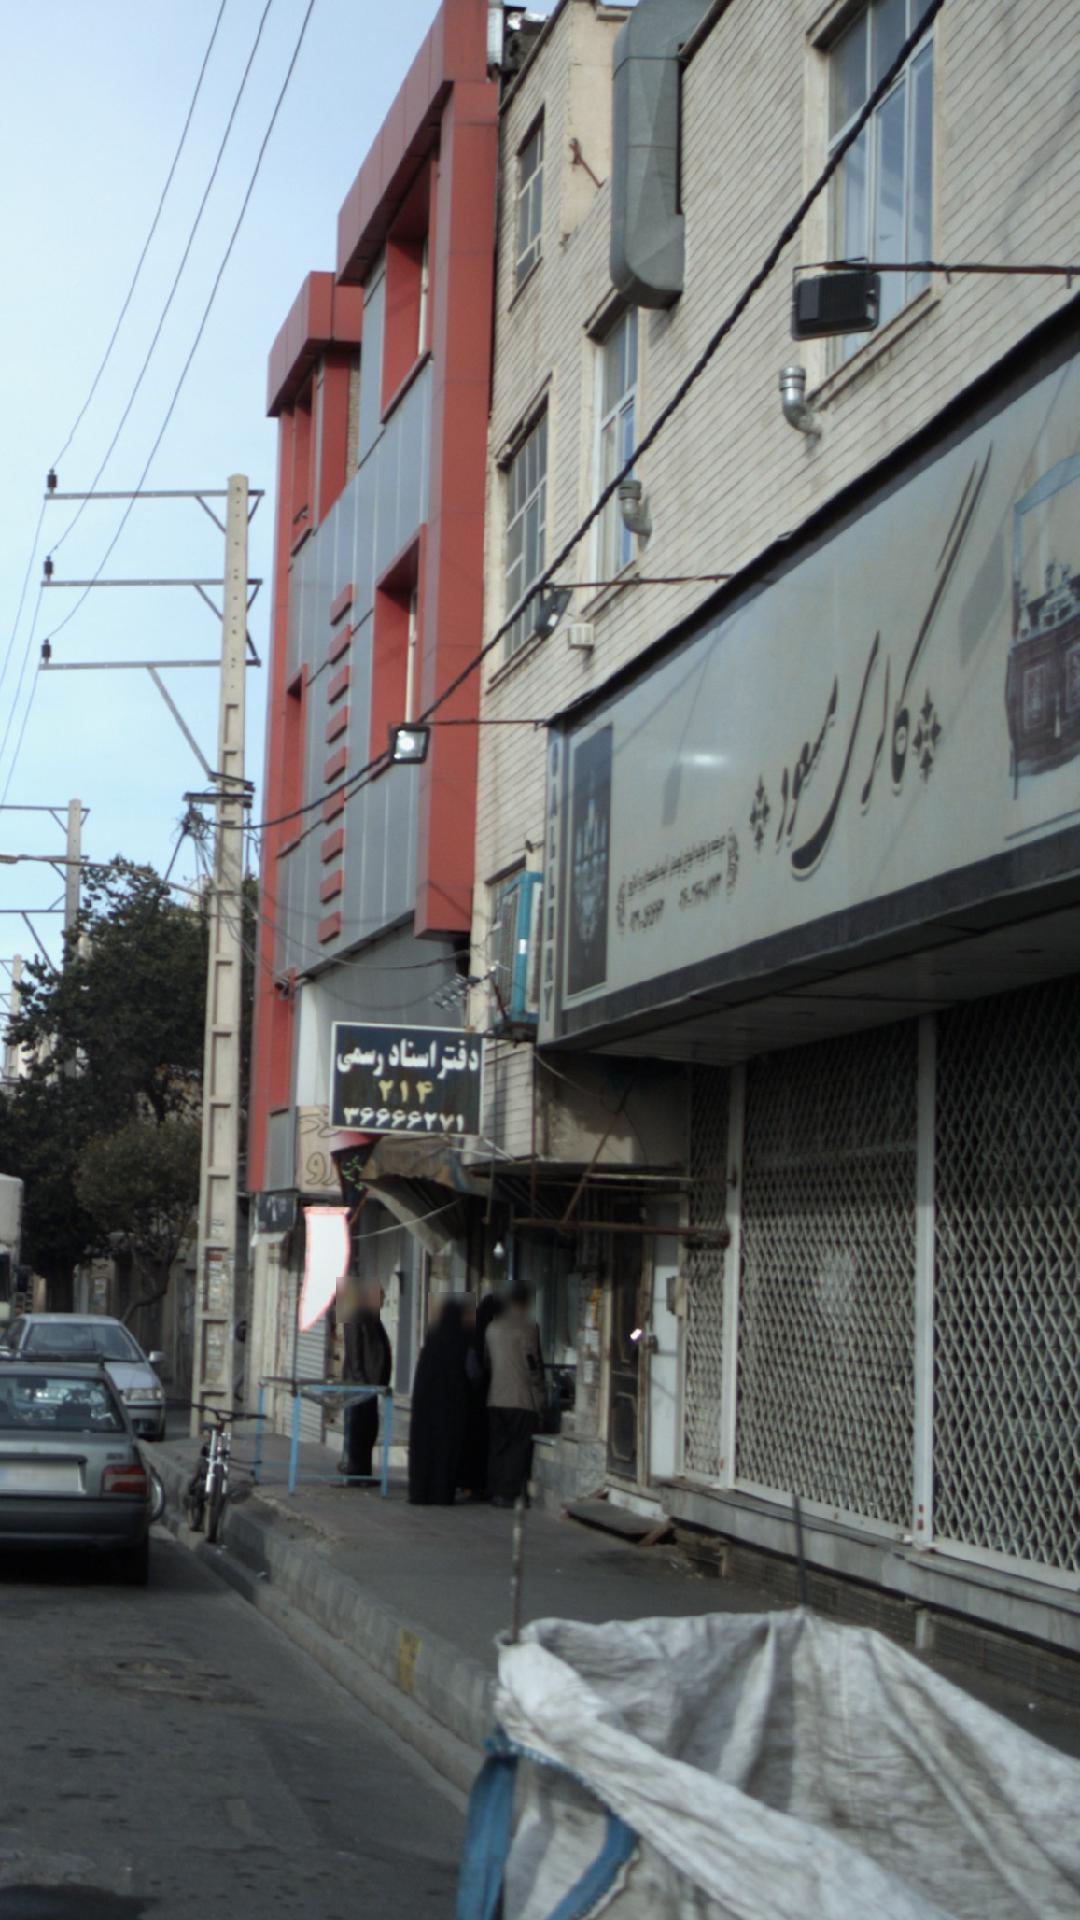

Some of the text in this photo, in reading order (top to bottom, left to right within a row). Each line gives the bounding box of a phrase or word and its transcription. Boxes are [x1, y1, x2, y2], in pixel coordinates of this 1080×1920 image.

[790, 440, 993, 872] گالری
[336, 1038, 479, 1080] دفتر اسناد رسمی
